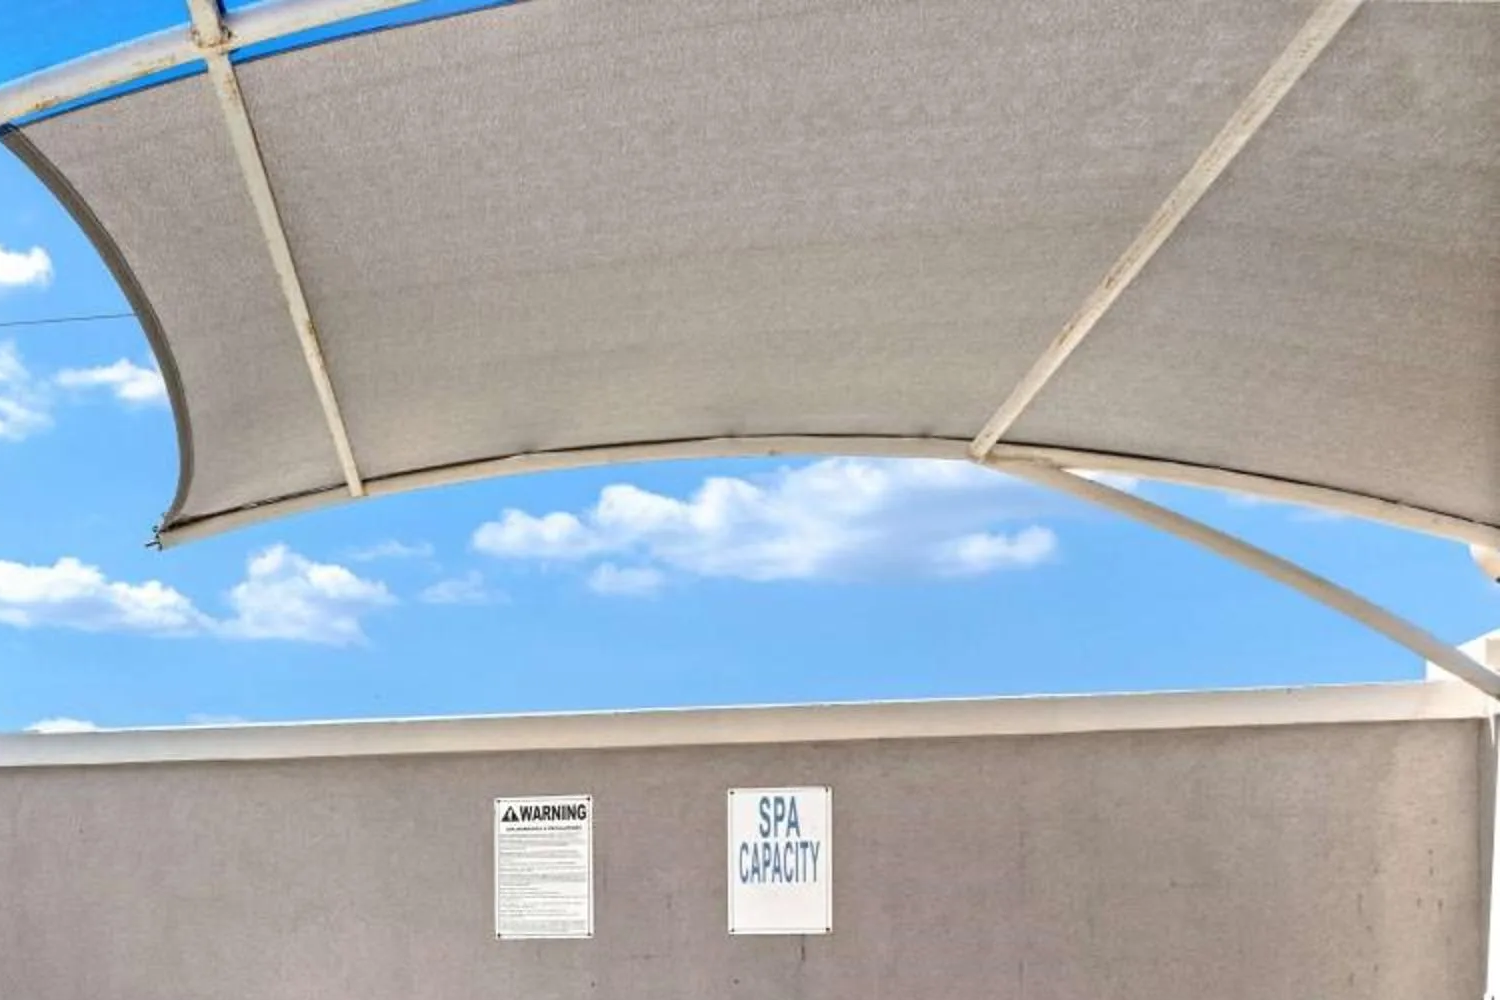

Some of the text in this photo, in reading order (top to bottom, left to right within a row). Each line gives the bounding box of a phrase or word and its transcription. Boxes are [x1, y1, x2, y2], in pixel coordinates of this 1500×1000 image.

[520, 804, 587, 821] WARNING
[759, 796, 800, 838] SPA
[739, 841, 820, 883] CAPACITY
